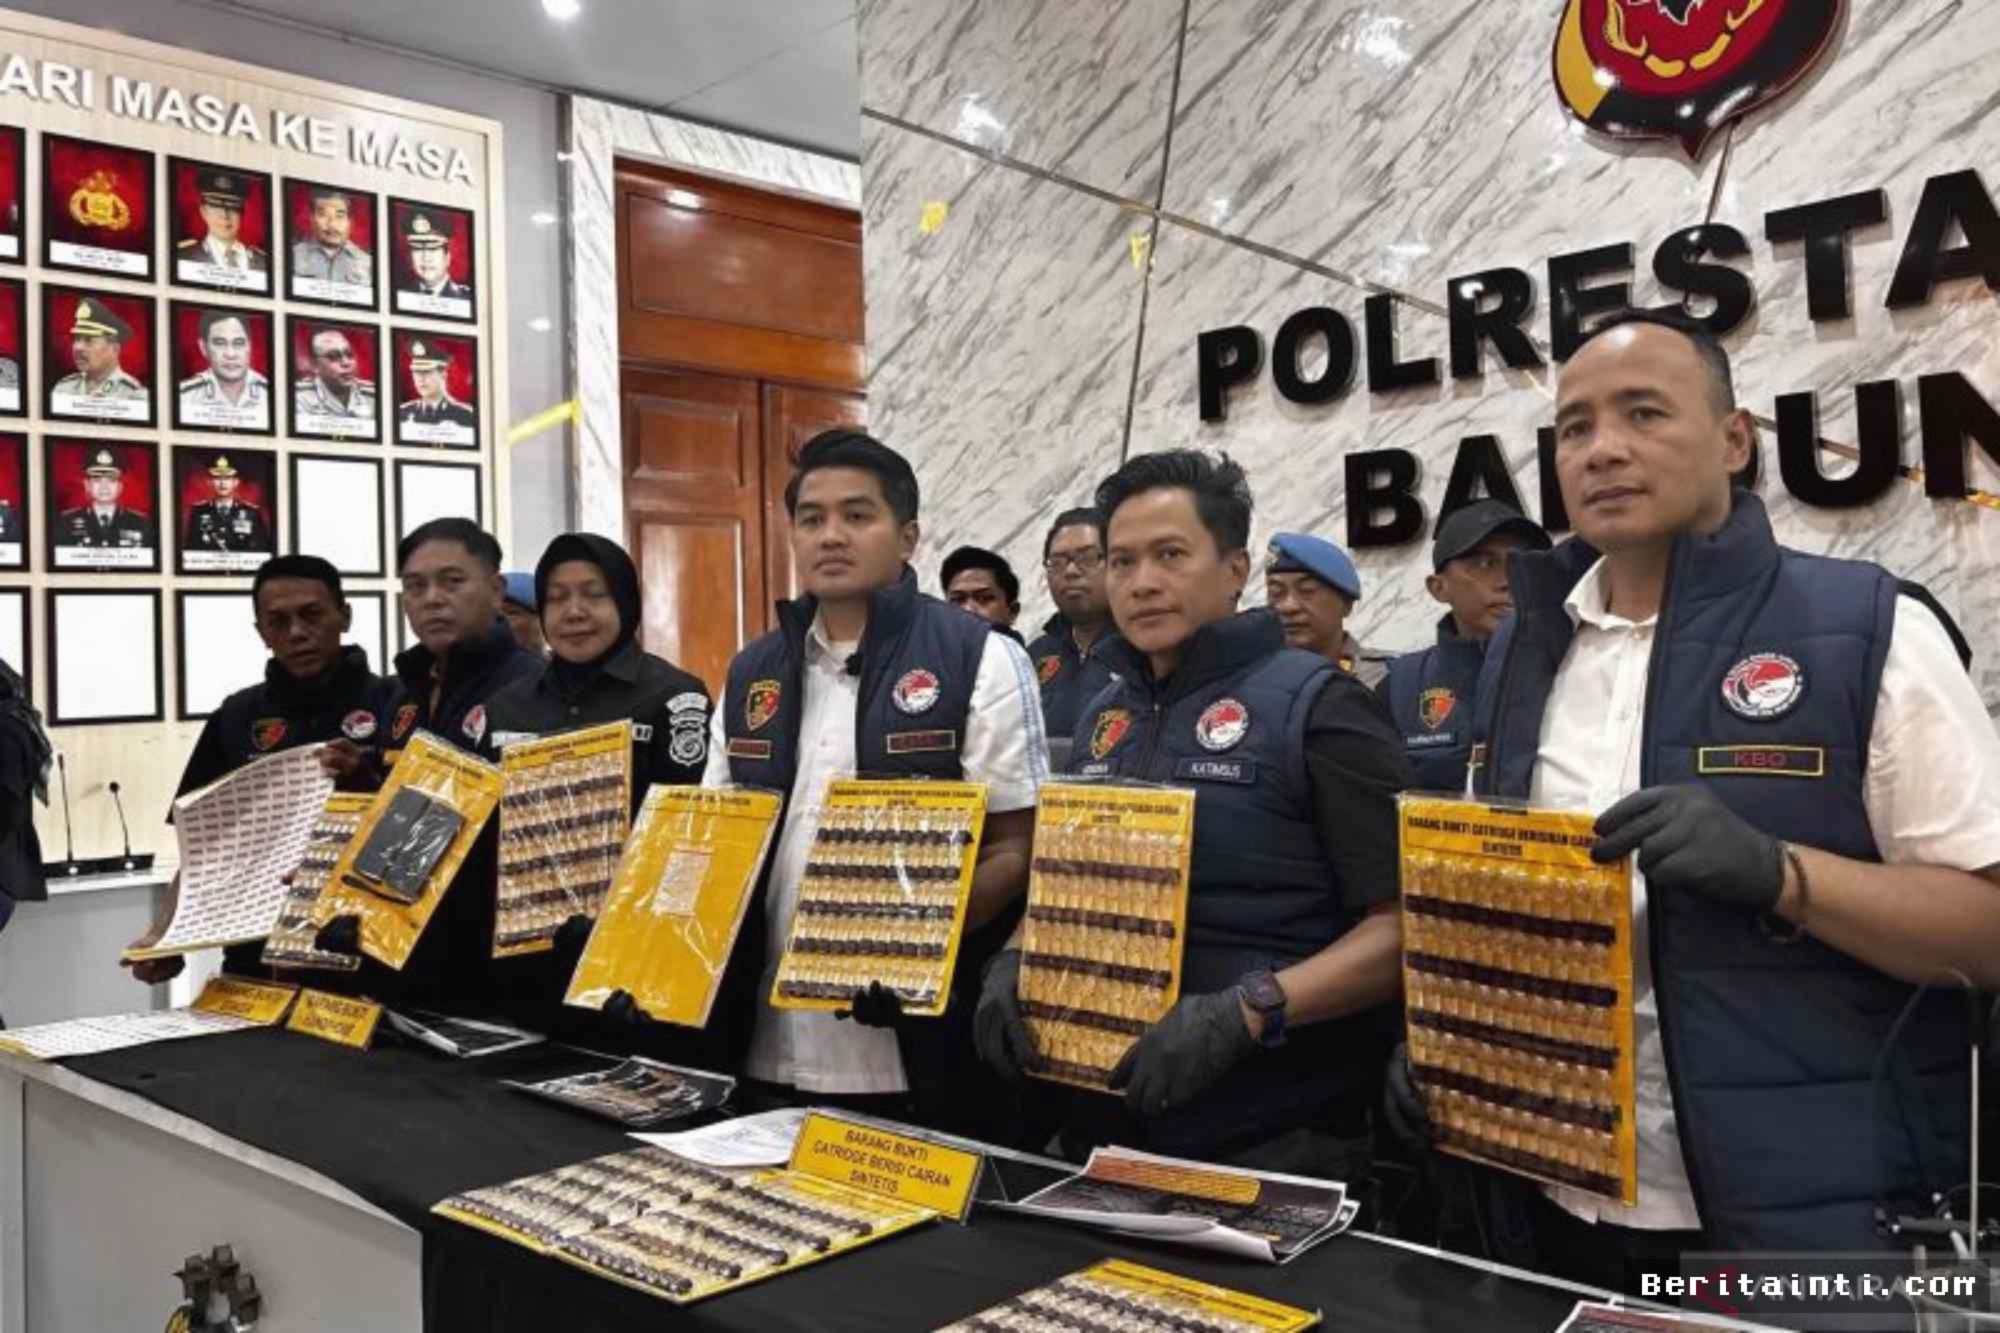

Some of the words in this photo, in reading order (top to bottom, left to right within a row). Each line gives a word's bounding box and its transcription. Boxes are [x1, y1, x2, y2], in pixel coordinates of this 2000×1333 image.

[0, 53, 94, 109] ARI
[110, 75, 262, 143] MASA
[273, 110, 338, 158] KE
[350, 128, 474, 186] MASA
[1197, 168, 2000, 422] POLRESTA
[1344, 370, 2000, 549] BAUN
[1734, 751, 1787, 767] KBO
[845, 1129, 891, 1150] BARANG
[893, 1142, 928, 1162] BUKTI
[849, 1168, 898, 1193] SINTETIS
[868, 1153, 905, 1177] BERISI
[907, 1163, 952, 1187] CAIRAN
